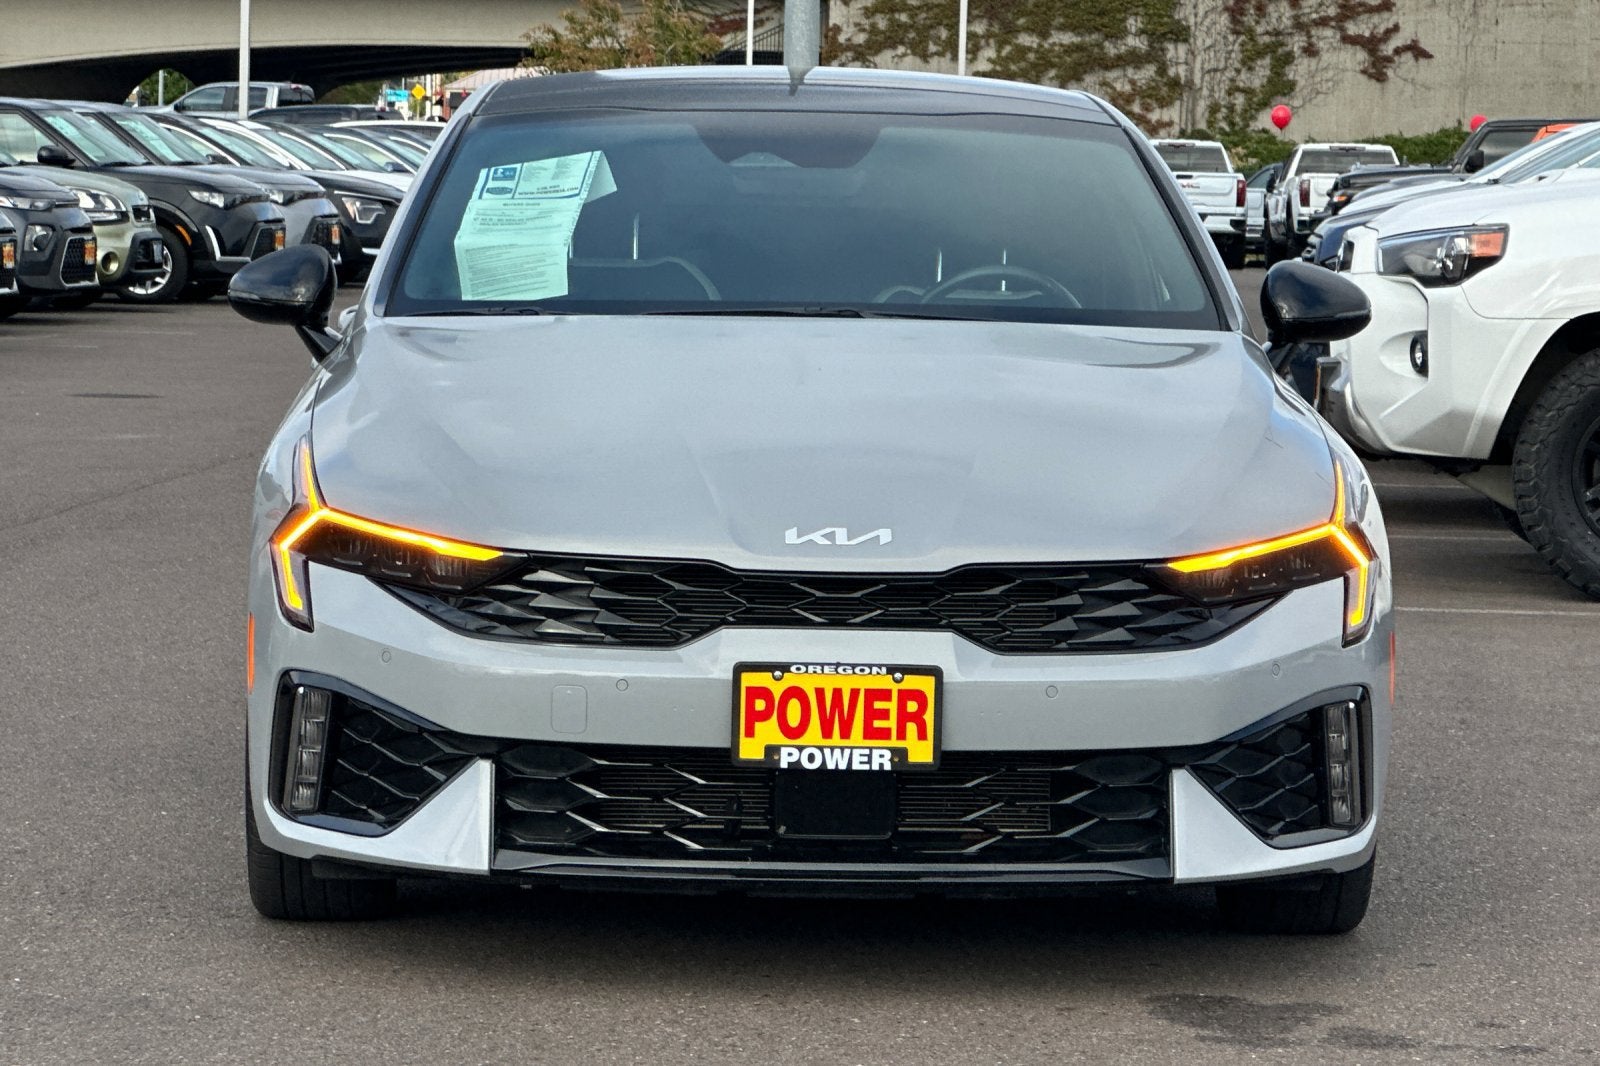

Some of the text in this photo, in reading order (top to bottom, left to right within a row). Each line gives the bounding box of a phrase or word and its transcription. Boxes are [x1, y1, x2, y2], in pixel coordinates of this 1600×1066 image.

[785, 526, 892, 545] KIA
[790, 664, 887, 675] OREGON
[744, 685, 929, 741] POWER
[780, 747, 892, 771] POWER
